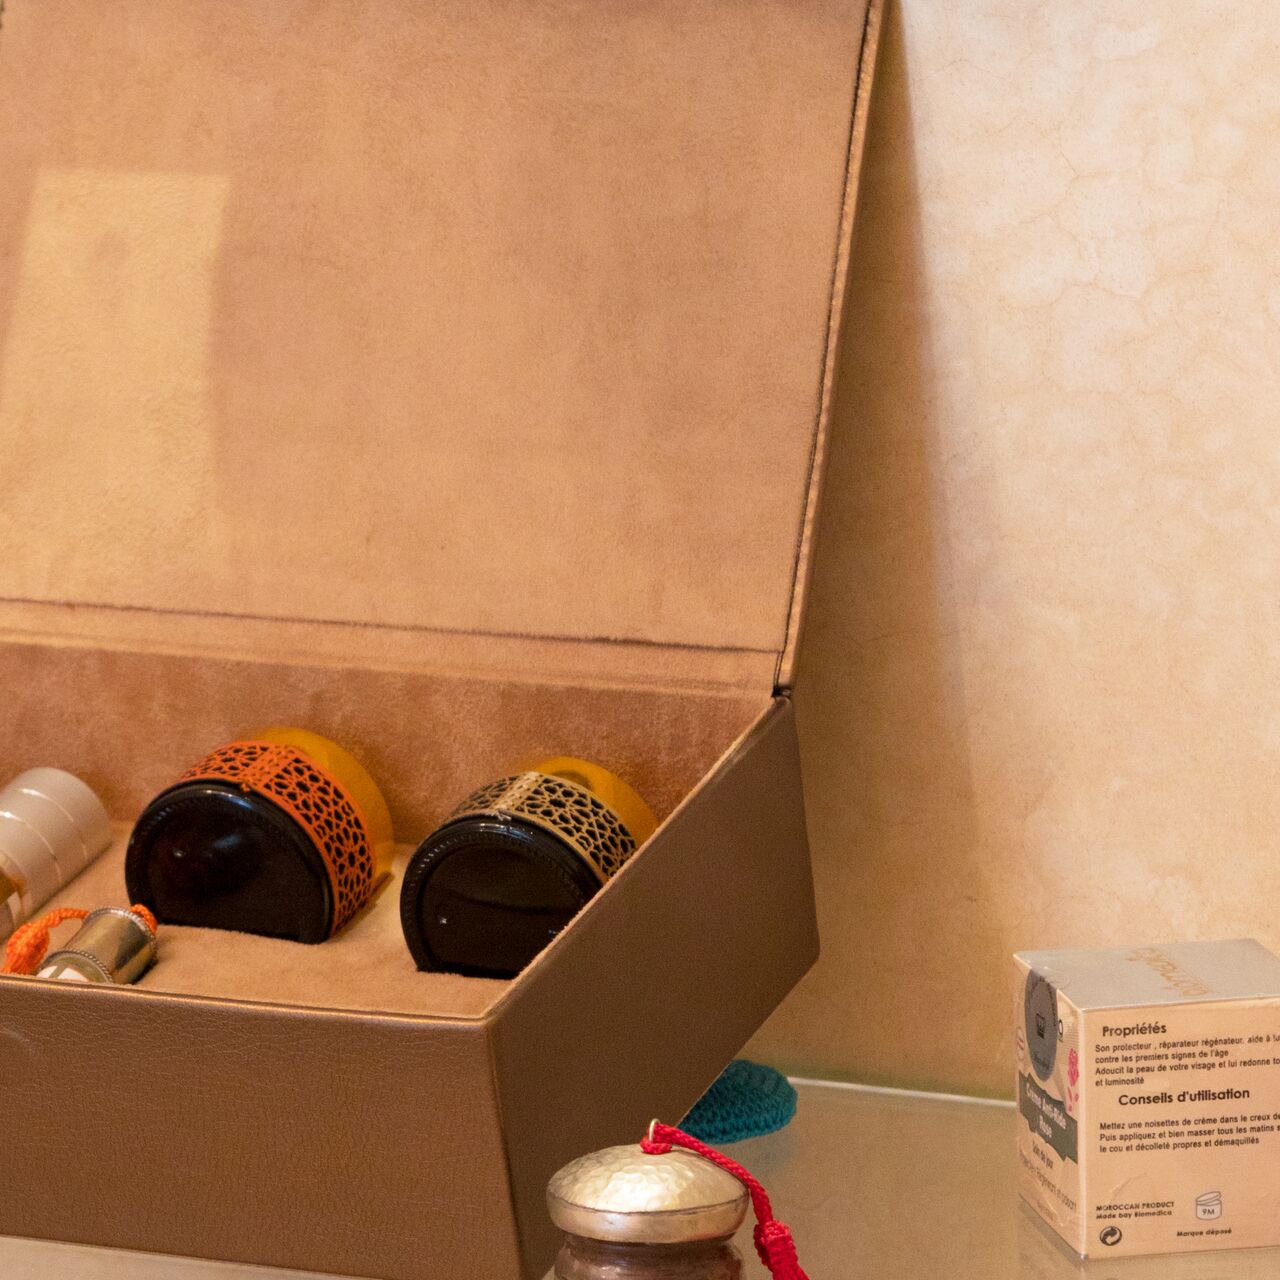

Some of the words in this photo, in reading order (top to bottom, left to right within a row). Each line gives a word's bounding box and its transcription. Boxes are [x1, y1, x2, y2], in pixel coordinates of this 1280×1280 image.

[1102, 1021, 1167, 1038] Propriétés
[1095, 1043, 1111, 1053] Son
[1112, 1041, 1152, 1053] protecteur
[1159, 1038, 1199, 1051] réparateur
[1247, 1034, 1263, 1044] aide
[1095, 1055, 1120, 1064] contre
[1121, 1054, 1133, 1063] les
[1135, 1052, 1169, 1066] premiers
[1171, 1051, 1196, 1061] signes
[1198, 1050, 1209, 1059] de
[1210, 1049, 1229, 1060] l'âge
[1095, 1066, 1125, 1076] Adoucit
[1136, 1064, 1155, 1075] peau
[1157, 1063, 1167, 1073] de
[1169, 1062, 1189, 1072] votre
[1191, 1061, 1216, 1072] visage
[1218, 1060, 1226, 1069] et
[1228, 1059, 1237, 1068] lui
[1239, 1057, 1271, 1067] redonne
[1095, 1078, 1103, 1087] et
[1105, 1075, 1144, 1086] luminosité
[1118, 1091, 1173, 1106] Conseils
[1177, 1087, 1251, 1103] d'utilisation
[1099, 1121, 1125, 1131] Mettez
[1128, 1121, 1143, 1129] une
[1144, 1118, 1180, 1128] noisettes
[1182, 1117, 1192, 1126] de
[1193, 1116, 1218, 1126] crème
[1220, 1115, 1239, 1124] dans
[1240, 1114, 1248, 1123] le
[1249, 1113, 1271, 1123] creux
[1099, 1133, 1117, 1142] Puis
[1119, 1131, 1156, 1142] appliquez
[1158, 1130, 1166, 1139] et
[1168, 1129, 1185, 1138] bien
[1187, 1128, 1215, 1138] masser
[1217, 1127, 1234, 1136] tous
[1236, 1126, 1247, 1135] les
[1249, 1124, 1275, 1134] matins
[1099, 1145, 1107, 1153] le
[1109, 1145, 1123, 1153] cou
[1125, 1143, 1133, 1152] et
[1135, 1141, 1171, 1152] décolleté
[1172, 1140, 1202, 1151] propres
[1204, 1139, 1212, 1148] et
[1214, 1137, 1260, 1148] démaquillés
[1096, 1203, 1140, 1212] MOROCCAN
[1141, 1201, 1175, 1210] PRODUCT
[1096, 1212, 1117, 1220] Made
[1134, 1209, 1173, 1218] Biomedica
[1201, 1208, 1215, 1216] 9M
[1176, 1229, 1204, 1237] Marque
[1206, 1227, 1232, 1236] déposé
